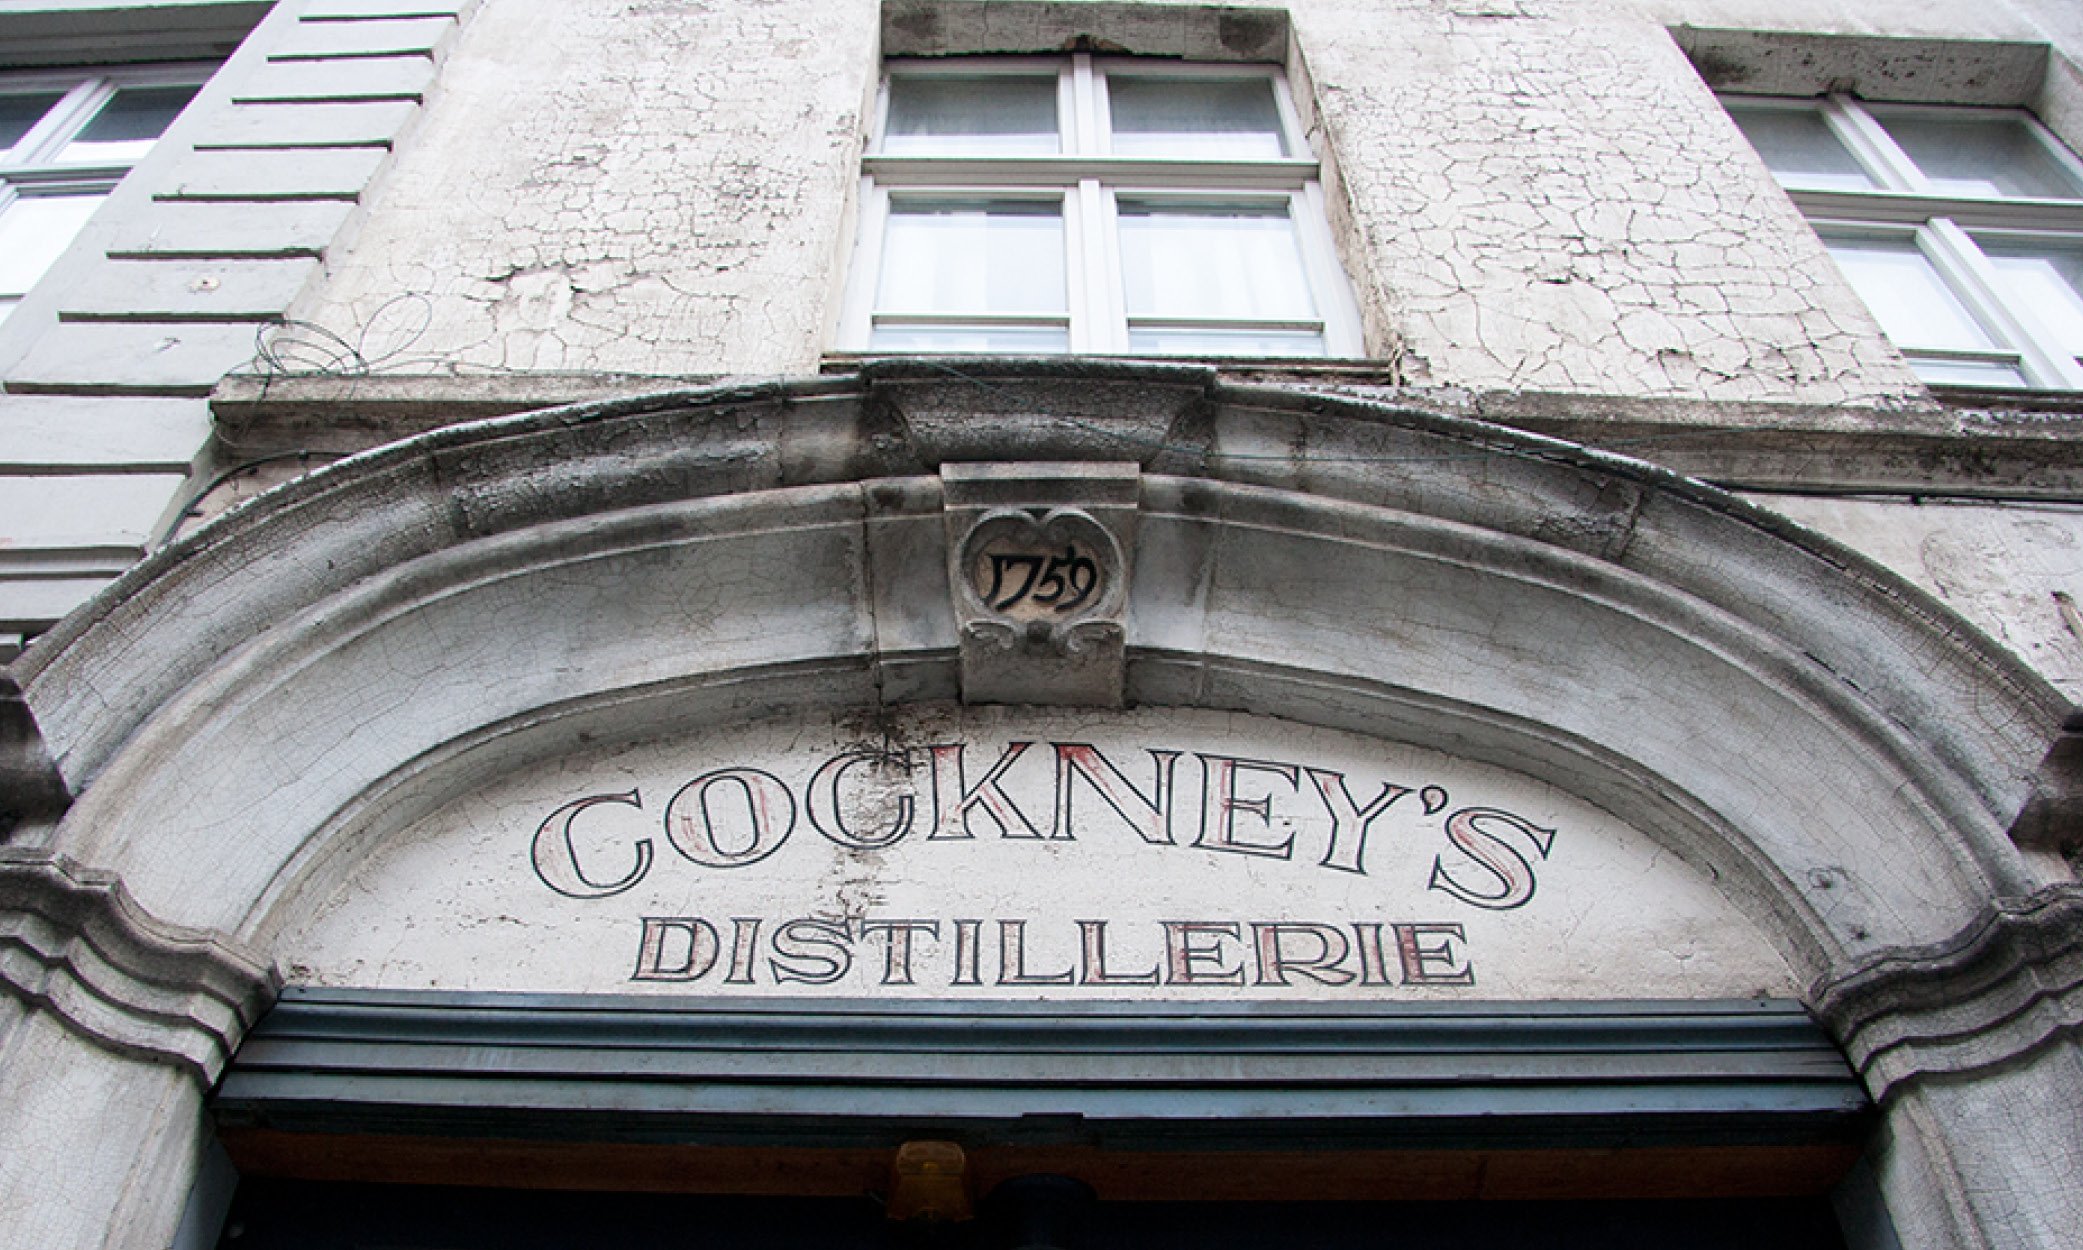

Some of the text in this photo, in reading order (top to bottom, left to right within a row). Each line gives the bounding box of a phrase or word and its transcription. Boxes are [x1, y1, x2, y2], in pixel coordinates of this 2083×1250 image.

[980, 544, 1098, 613] 1759
[530, 741, 1557, 910] COCKNEY'S
[629, 916, 1476, 987] DISTILLERIE
